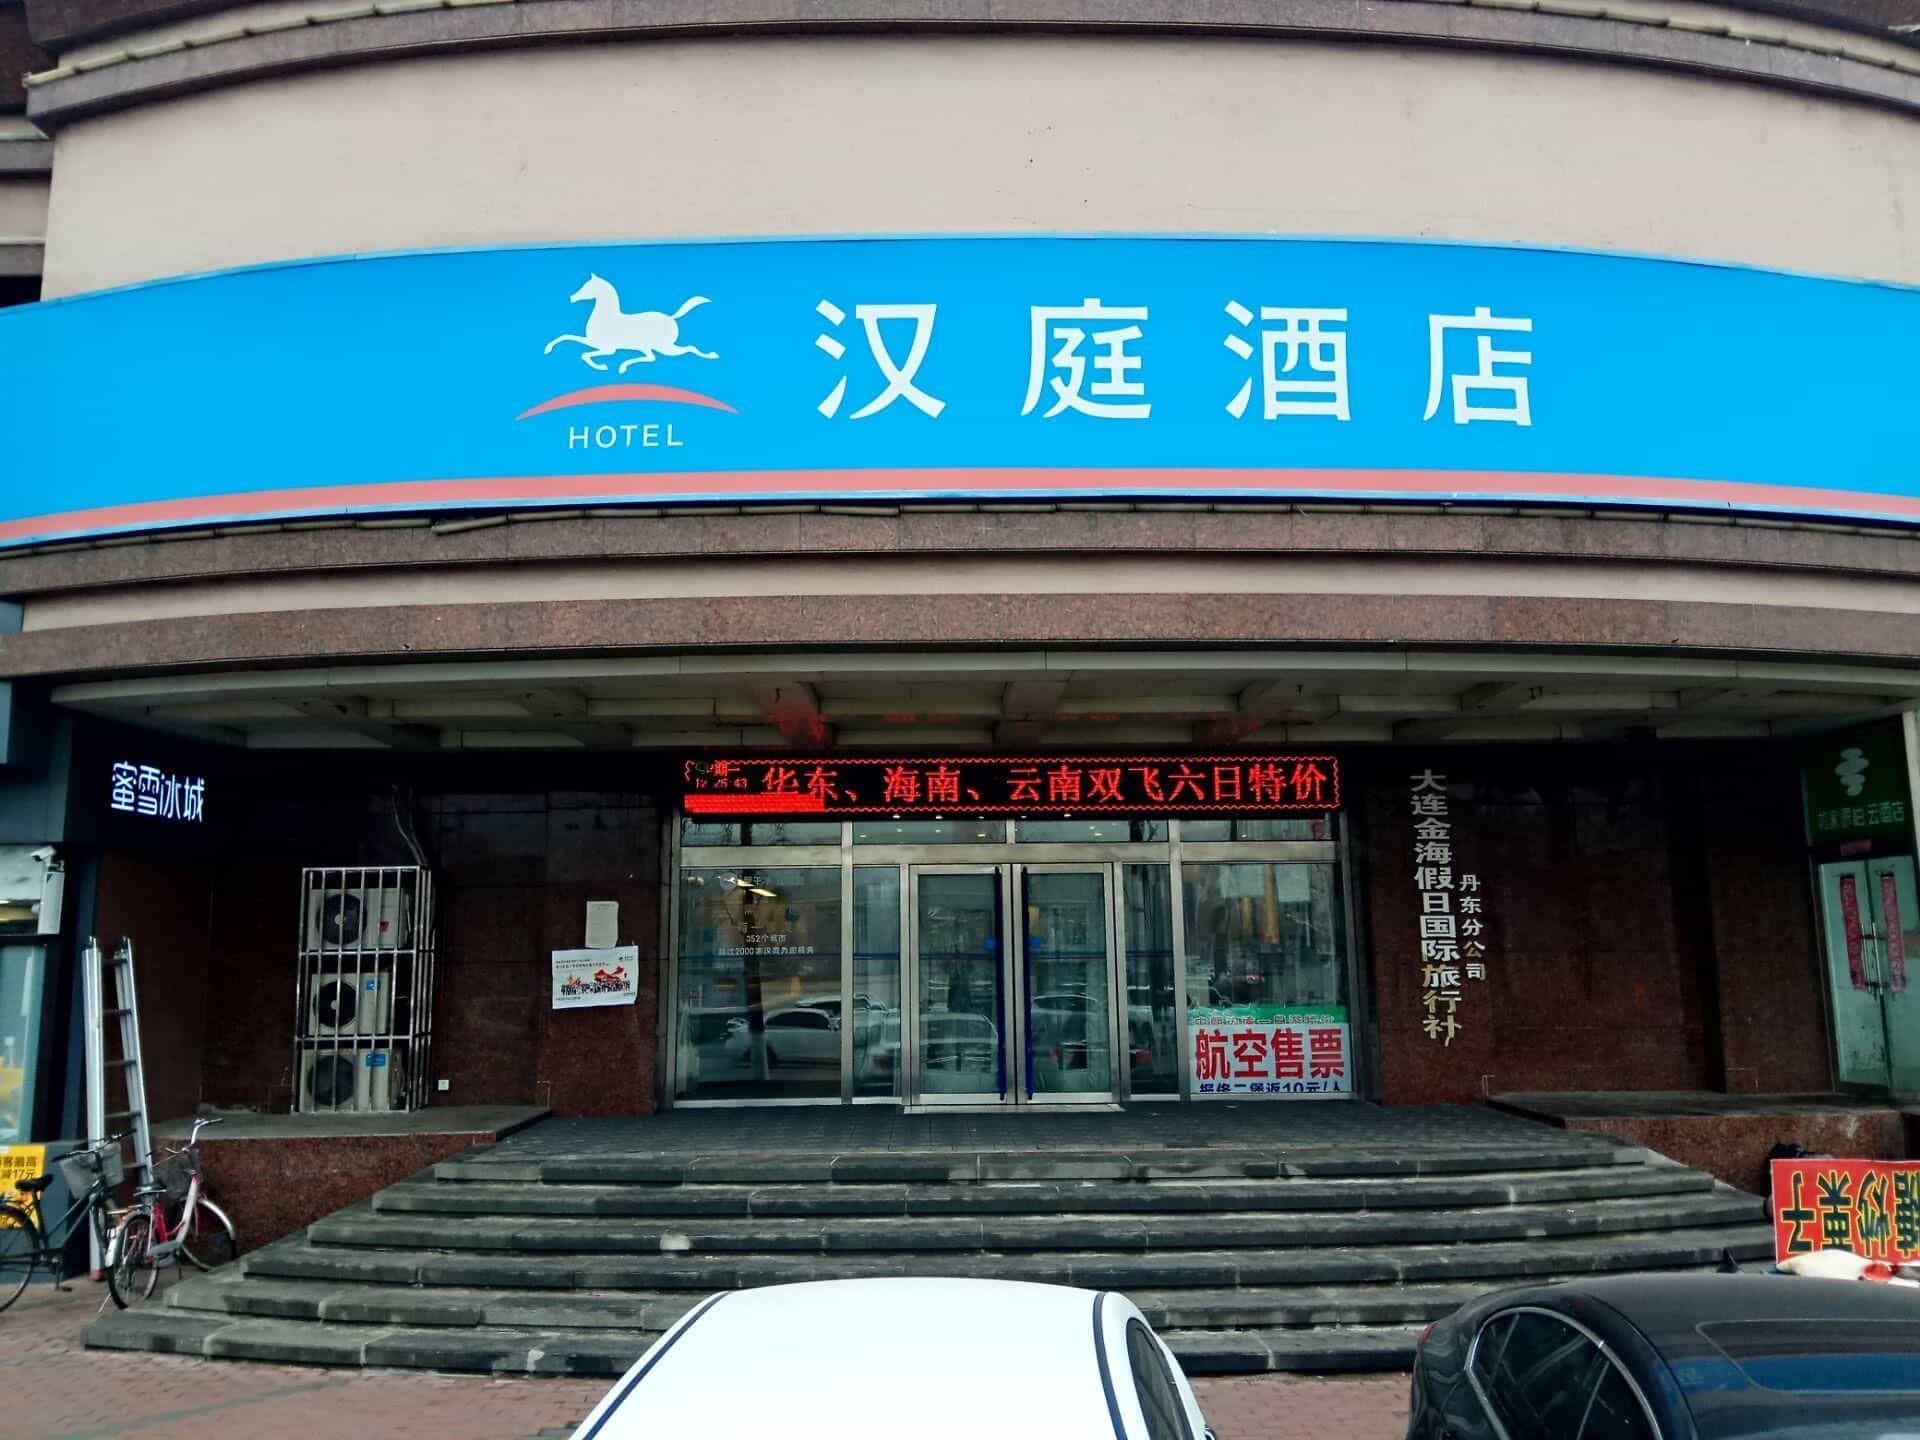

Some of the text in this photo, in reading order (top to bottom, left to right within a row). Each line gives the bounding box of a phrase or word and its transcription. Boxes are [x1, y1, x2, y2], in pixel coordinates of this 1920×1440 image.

[815, 298, 1533, 426] 汉庭酒店
[568, 424, 682, 450] HOTEL
[110, 760, 206, 824] 蜜雪冰城
[1459, 874, 1487, 981] 丹东分公司
[1195, 1028, 1344, 1080] 航空售票
